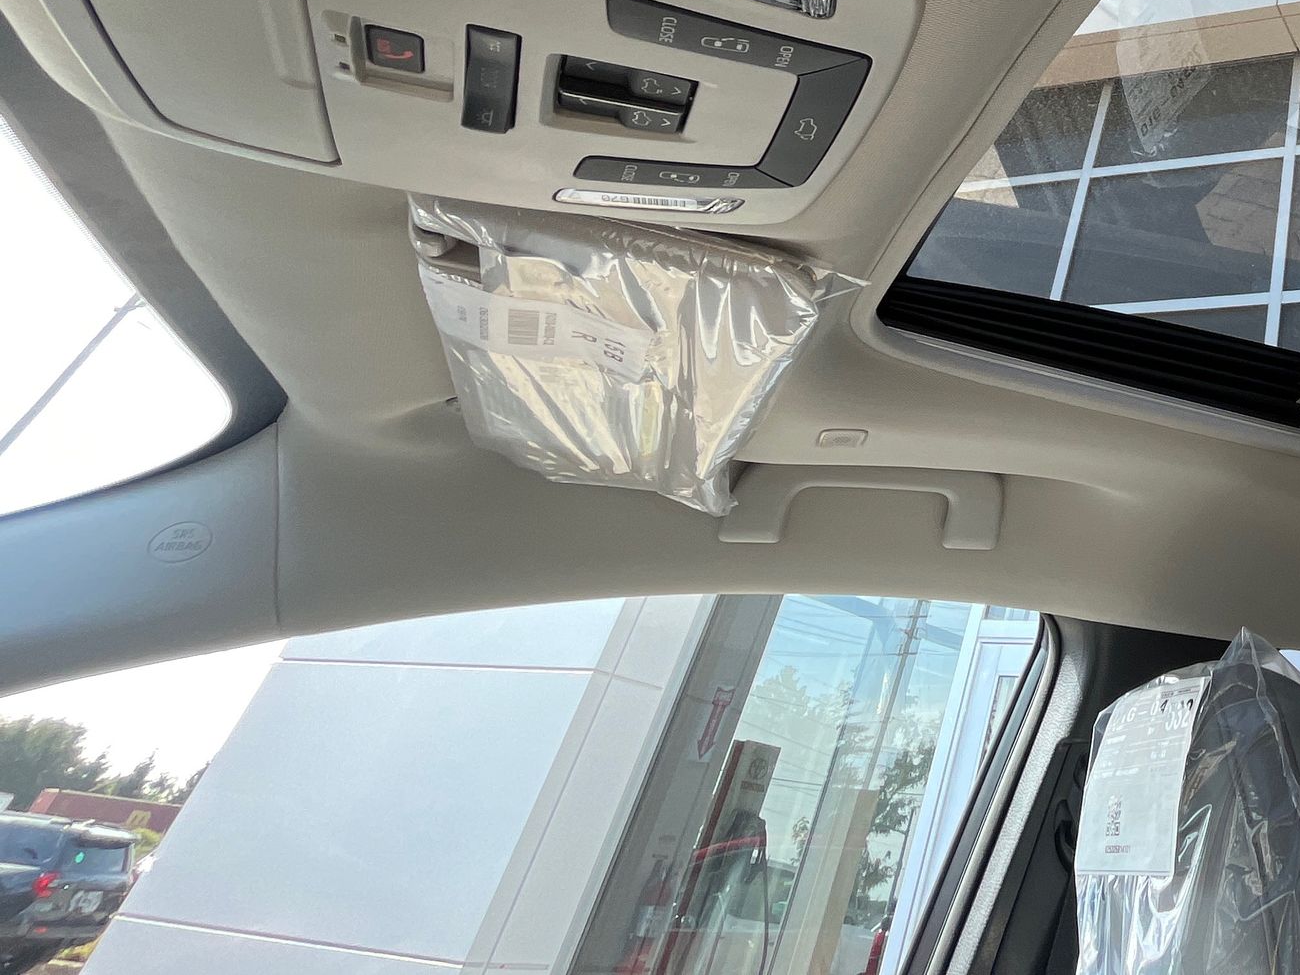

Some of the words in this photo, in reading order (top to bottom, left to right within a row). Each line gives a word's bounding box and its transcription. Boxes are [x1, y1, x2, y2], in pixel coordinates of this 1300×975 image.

[658, 17, 677, 44] CLOSE
[775, 45, 794, 69] OPEN
[571, 330, 598, 345] R
[154, 540, 203, 552] AIRBAG
